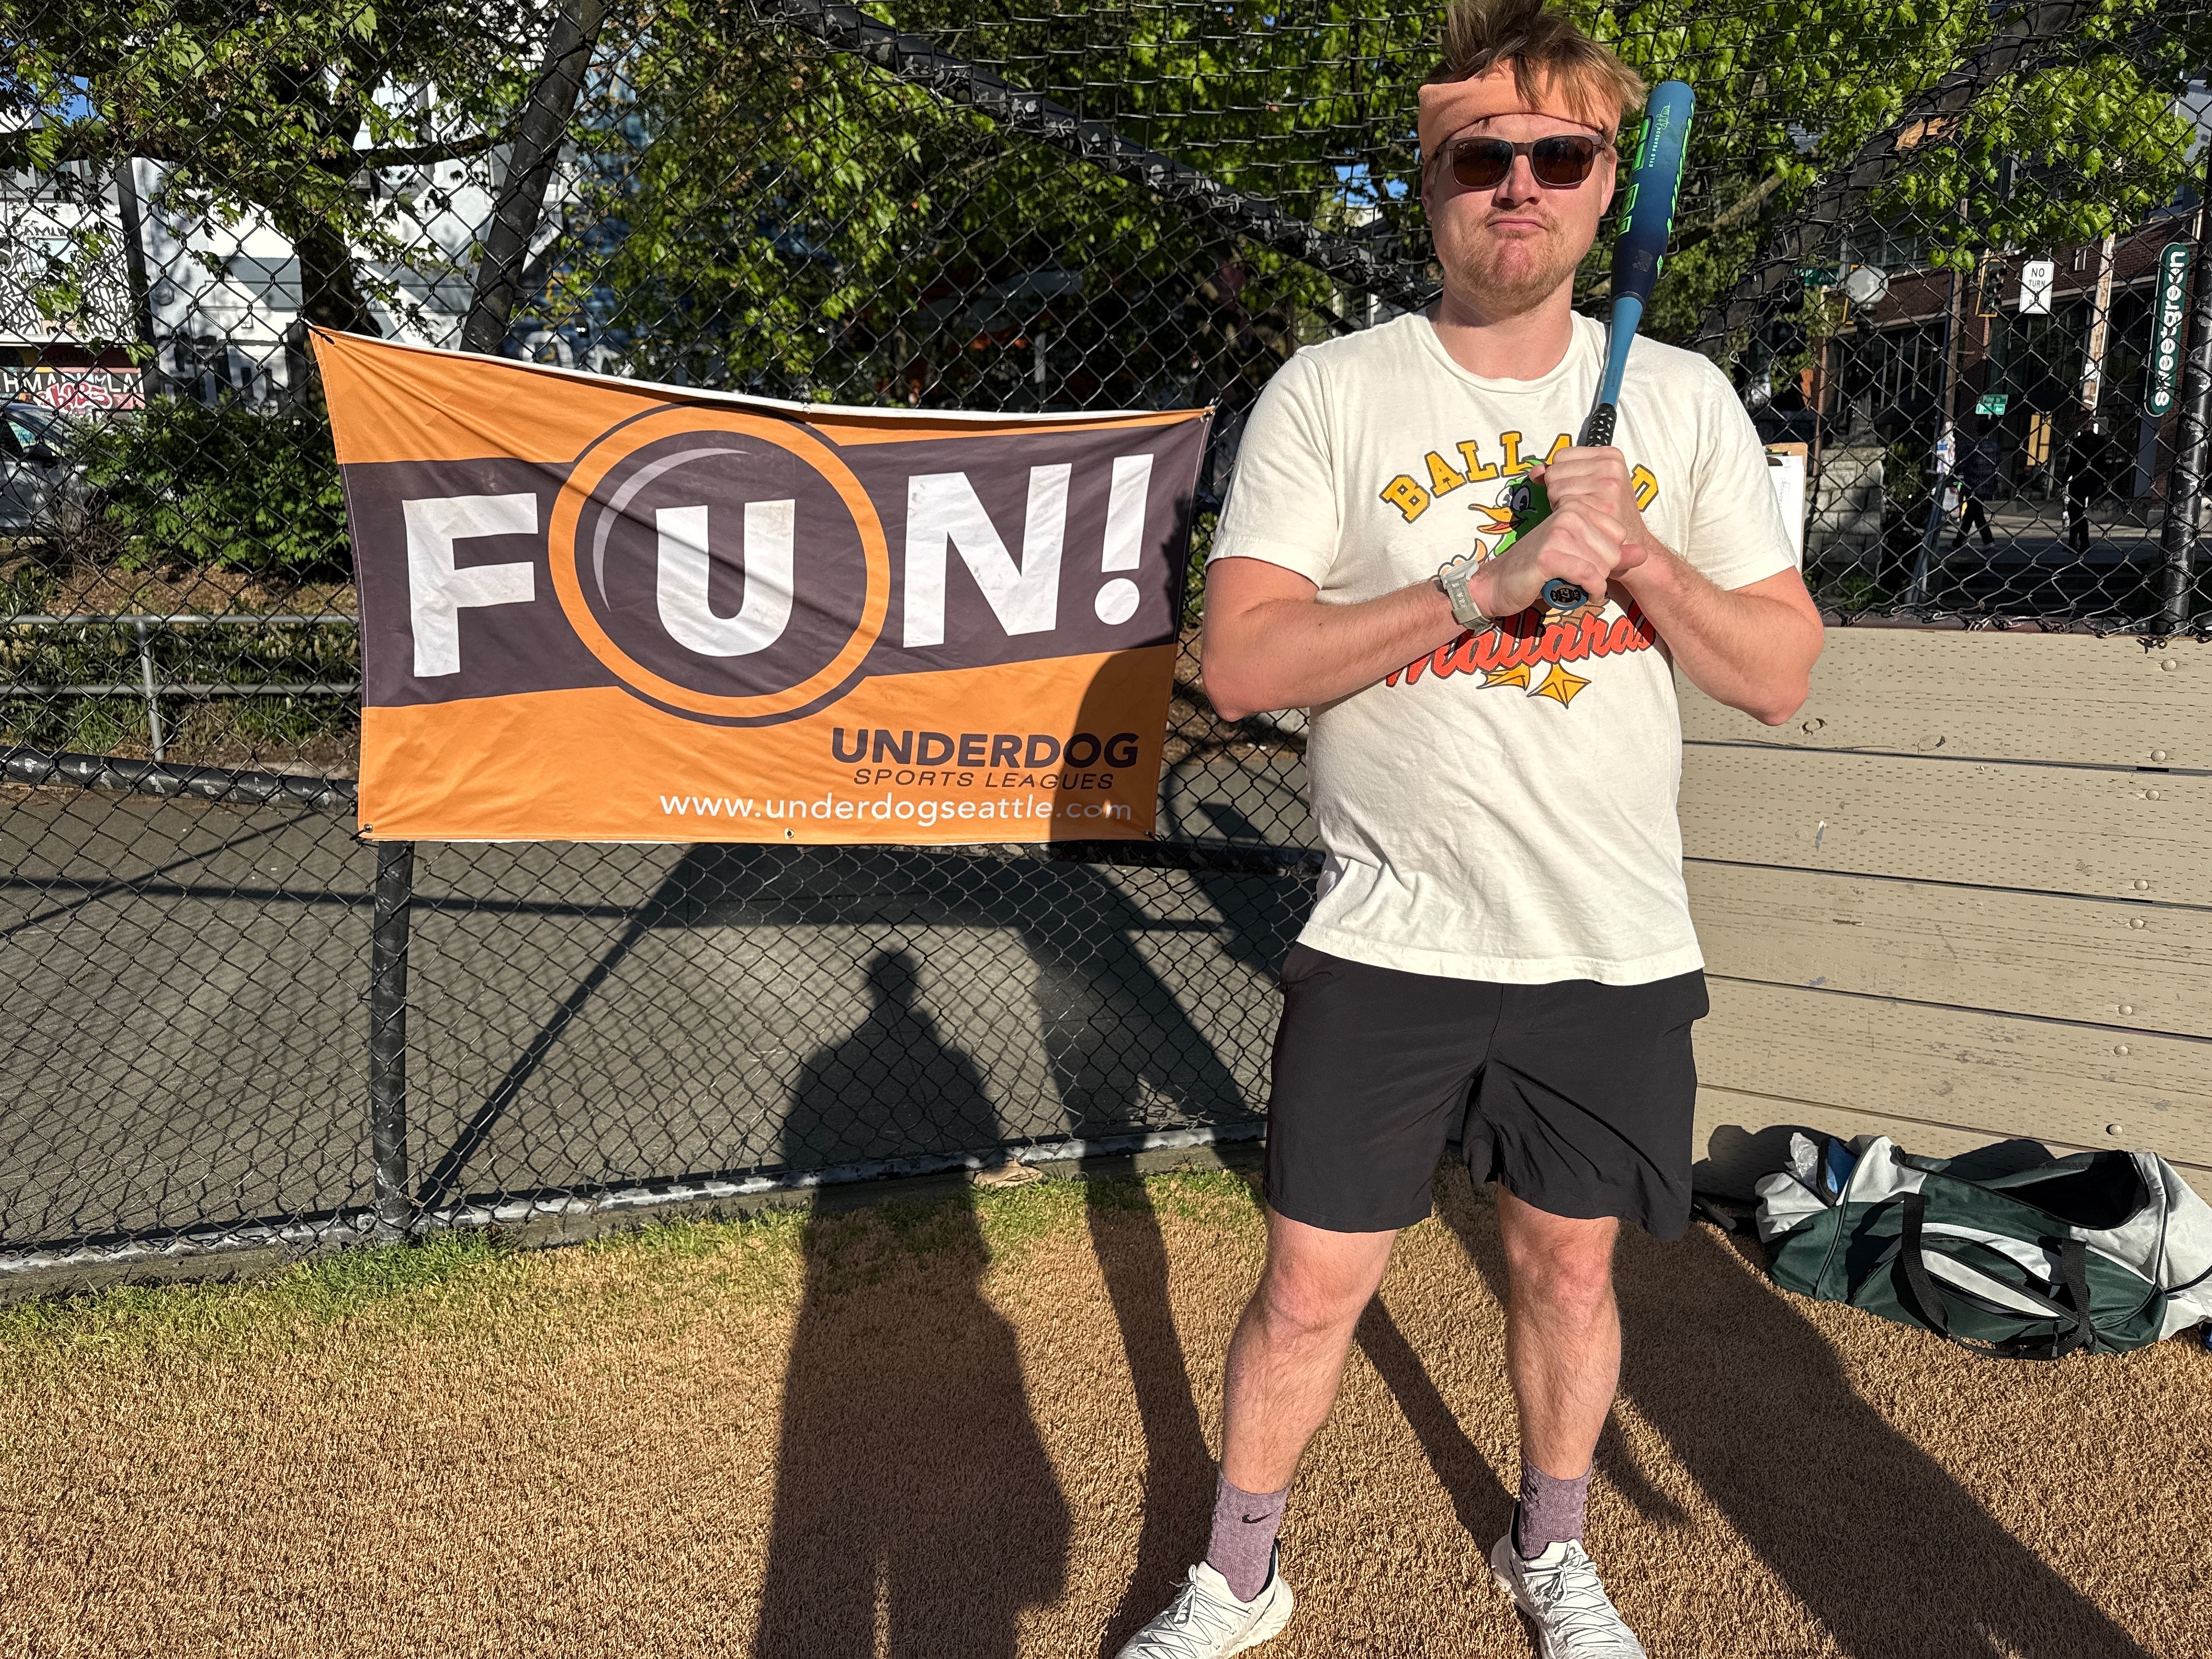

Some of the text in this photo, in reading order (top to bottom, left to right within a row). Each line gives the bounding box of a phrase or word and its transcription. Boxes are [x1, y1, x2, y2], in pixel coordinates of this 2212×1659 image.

[2028, 279, 2046, 288] TURN
[2031, 267, 2045, 278] NO
[1379, 431, 1660, 524] BALLD
[403, 453, 1155, 677] FUN!
[832, 727, 1139, 769] UNDERDOG
[853, 769, 1114, 790] SPORTS LEAGUES
[659, 792, 1132, 827] www.underdogseattle.com
